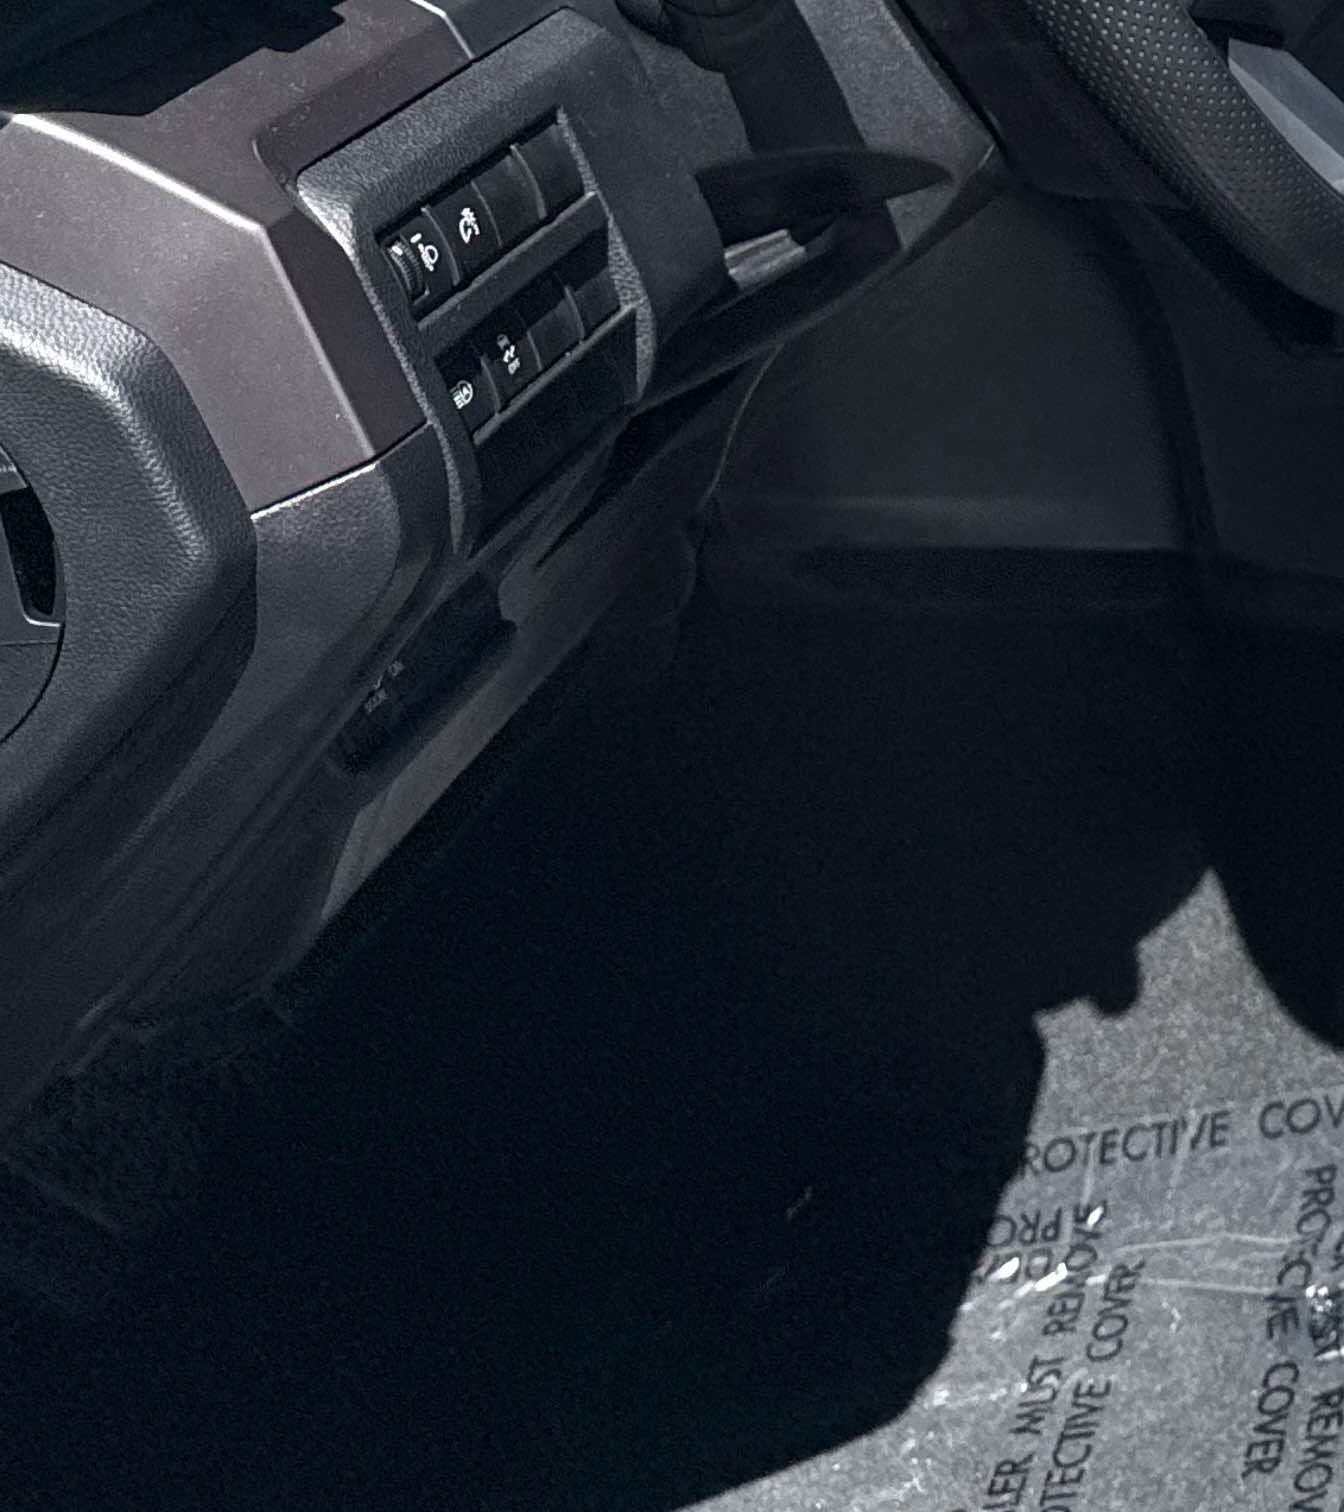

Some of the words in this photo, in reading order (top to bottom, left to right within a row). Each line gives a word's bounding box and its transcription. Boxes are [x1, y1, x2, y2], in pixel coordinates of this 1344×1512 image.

[1085, 1257, 1147, 1363] COVER
[1008, 1354, 1069, 1435] MUST
[1240, 1360, 1300, 1480] COVER
